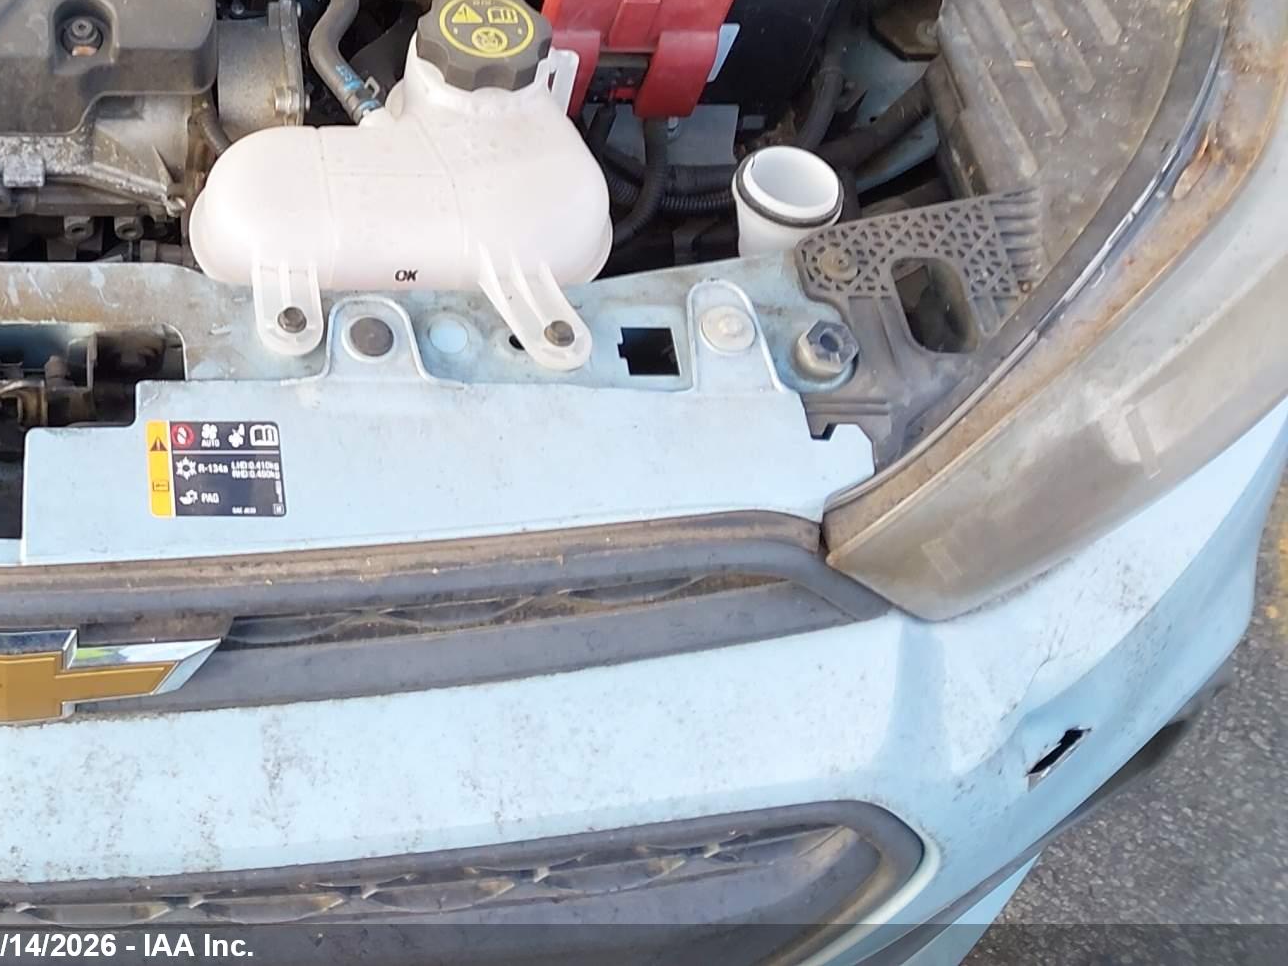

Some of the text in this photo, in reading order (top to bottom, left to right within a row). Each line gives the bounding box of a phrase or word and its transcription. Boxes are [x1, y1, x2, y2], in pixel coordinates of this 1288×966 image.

[394, 269, 418, 283] OK
[201, 439, 220, 448] AUTO
[198, 463, 229, 474] R-134a
